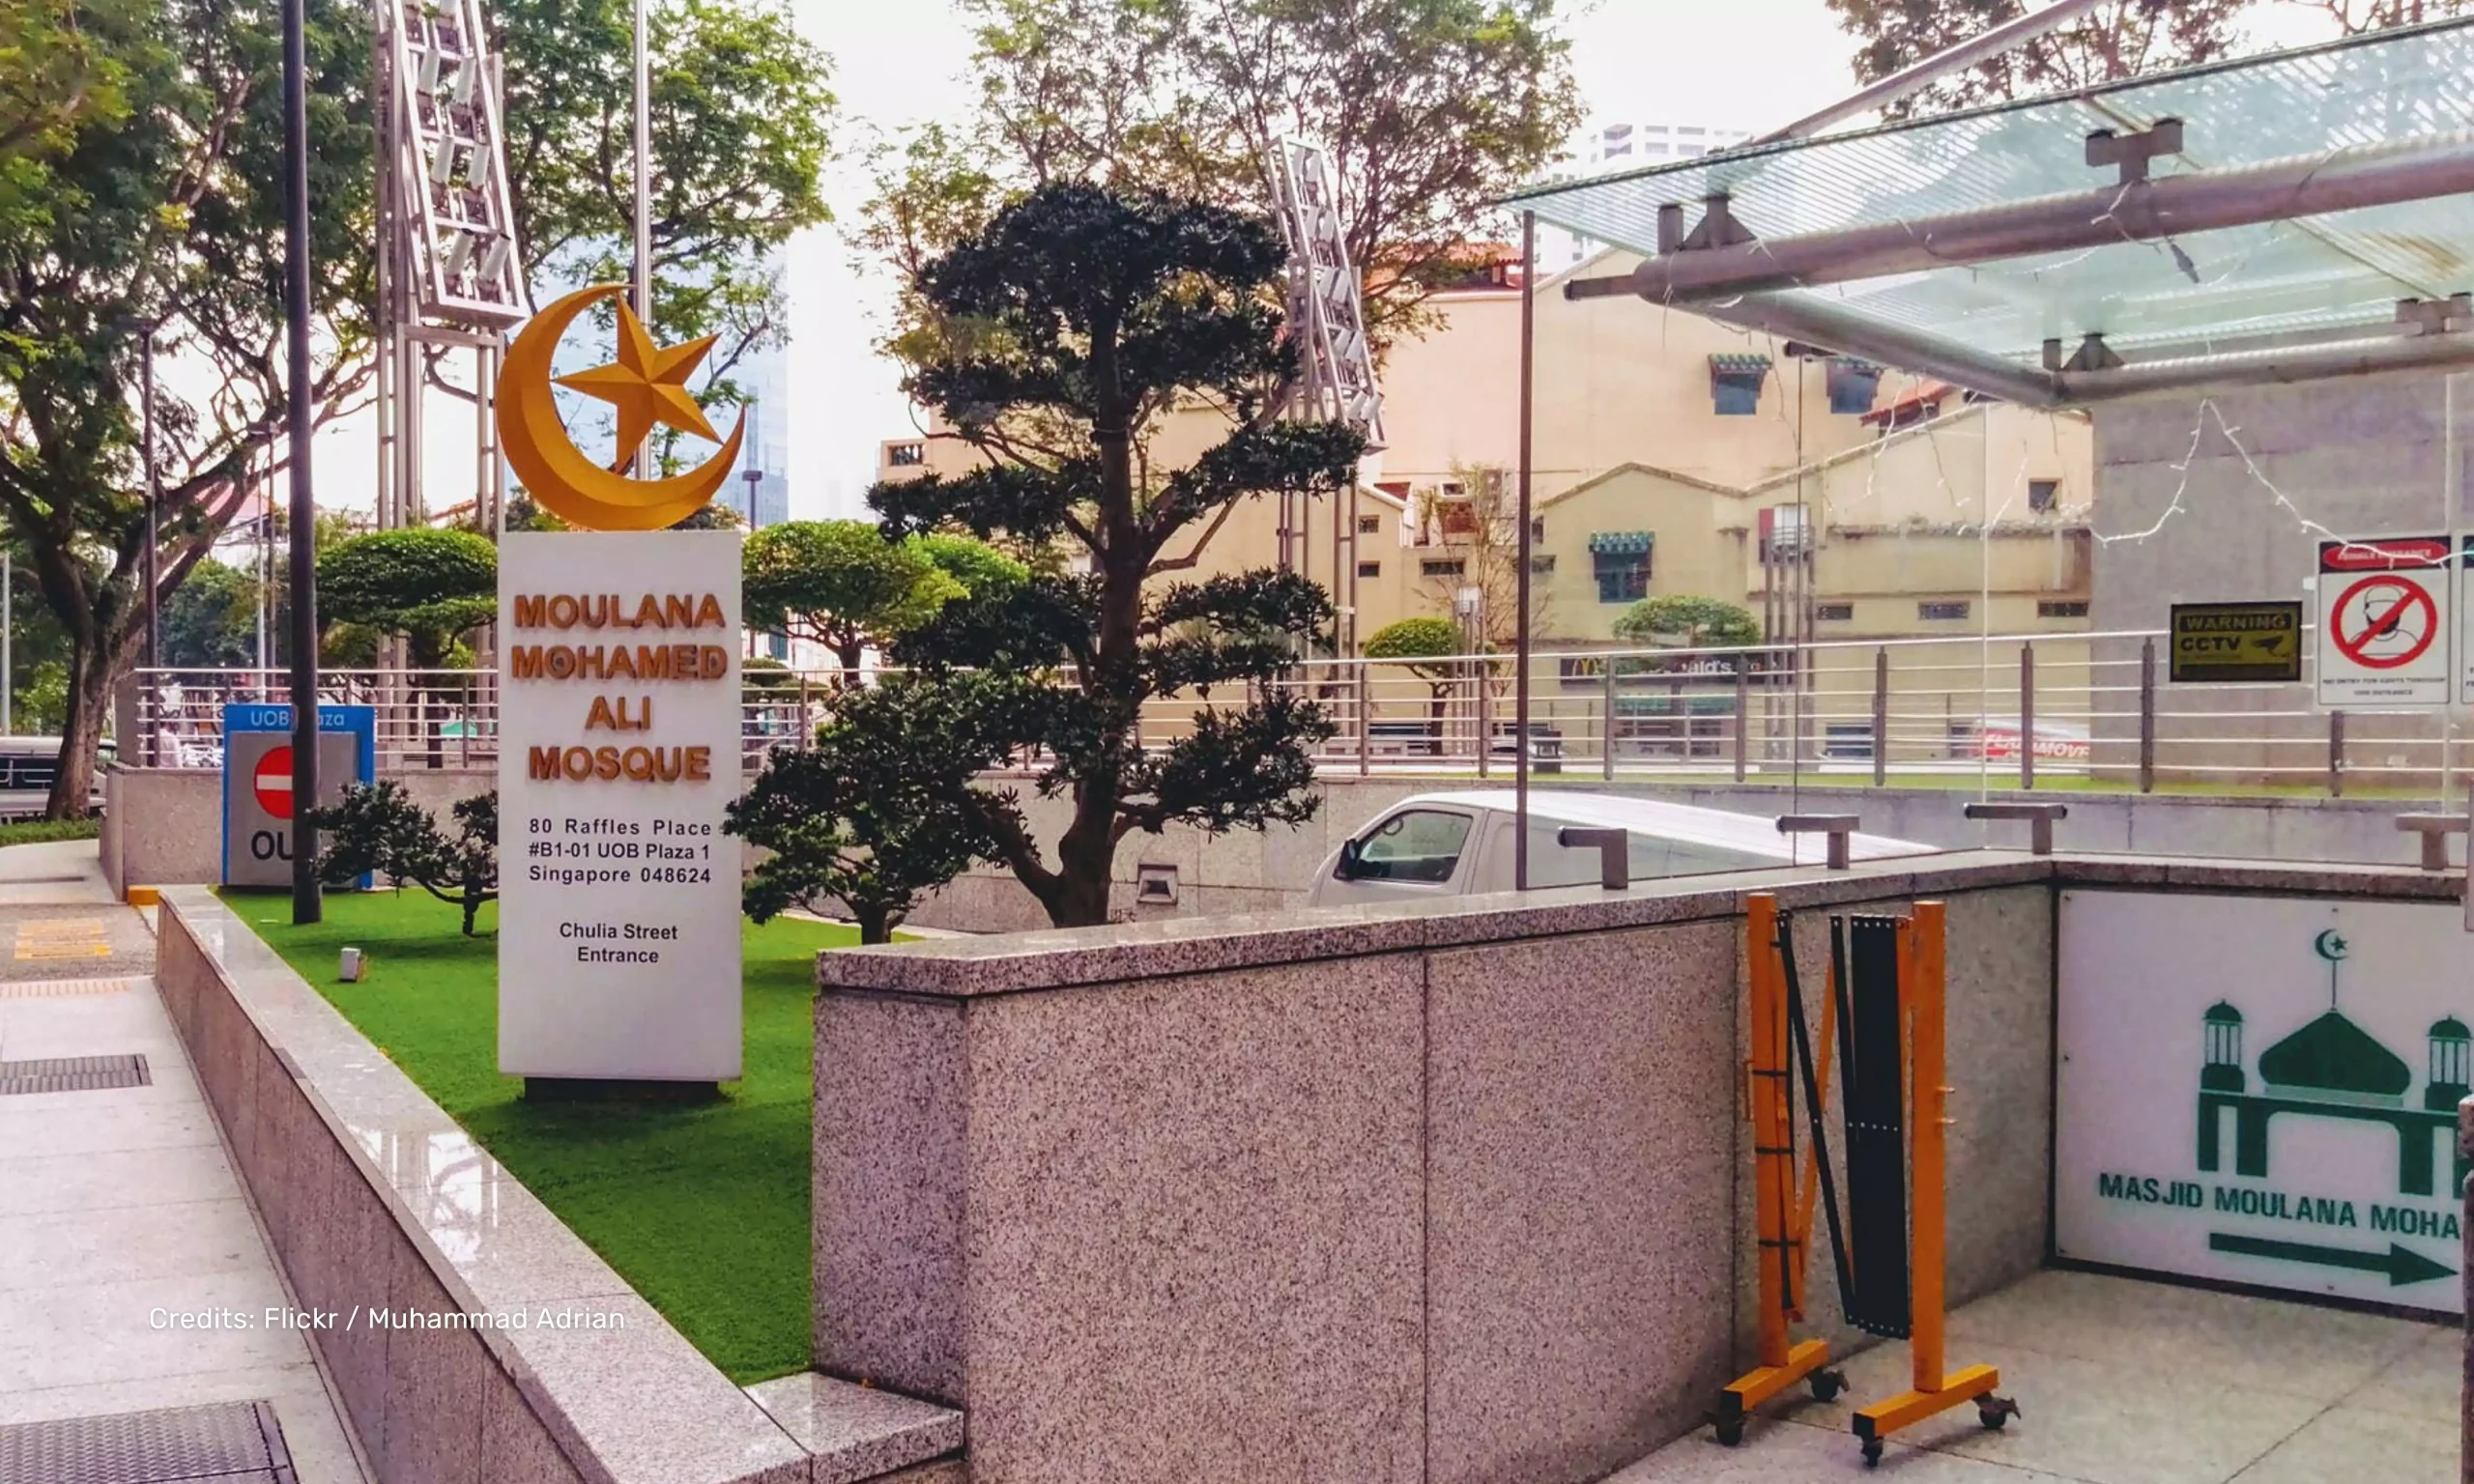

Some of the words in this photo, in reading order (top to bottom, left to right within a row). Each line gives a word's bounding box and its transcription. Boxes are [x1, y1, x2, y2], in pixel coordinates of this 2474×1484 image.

[514, 593, 726, 628] MOULANA
[2186, 614, 2287, 631] WARNING
[2180, 636, 2242, 652] CCTV
[511, 644, 728, 679] MOHAMED
[250, 710, 290, 726] UOB
[585, 695, 651, 730] ALI
[529, 746, 711, 783] MOSQUE
[530, 818, 552, 834] 80
[565, 818, 640, 835] Raffles
[653, 819, 711, 836] Place
[251, 830, 293, 860] OU
[529, 842, 590, 858] #B1-01
[598, 843, 639, 858] UOB
[646, 843, 695, 860] Plaza
[702, 844, 709, 860] 1
[530, 866, 631, 885] Singapore
[641, 868, 711, 883] 048624
[560, 922, 618, 939] Chulia
[623, 924, 678, 940] Street
[578, 947, 659, 963] Entrance
[2099, 1173, 2204, 1209] MASJID
[2214, 1186, 2357, 1228] MOULANA
[2371, 1205, 2461, 1241] MOHA
